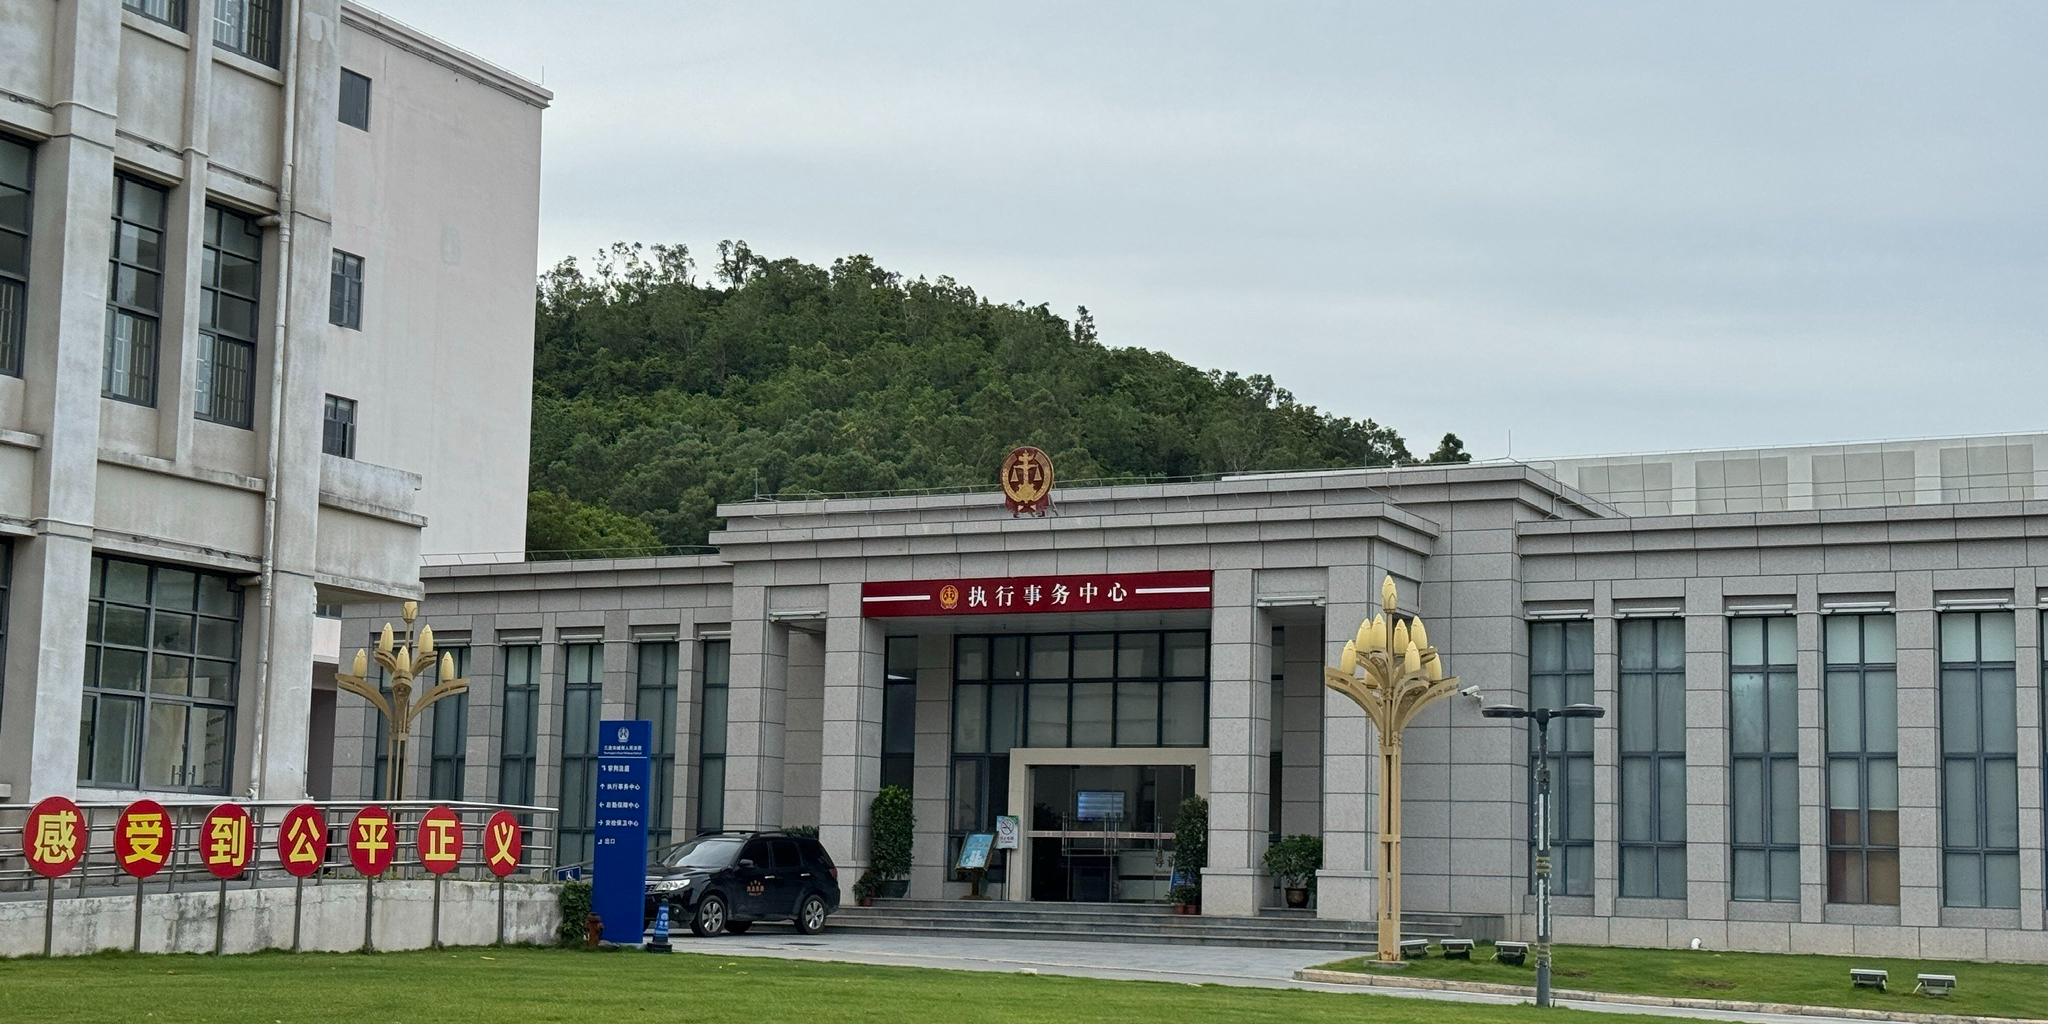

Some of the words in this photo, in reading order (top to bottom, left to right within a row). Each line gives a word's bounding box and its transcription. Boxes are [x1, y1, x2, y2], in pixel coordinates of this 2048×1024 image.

[968, 582, 1128, 608] 执行事务中心
[606, 783, 641, 791] 执行事务中心
[605, 801, 640, 809] 后勤保障中心
[33, 811, 516, 867] 感受到公平正义
